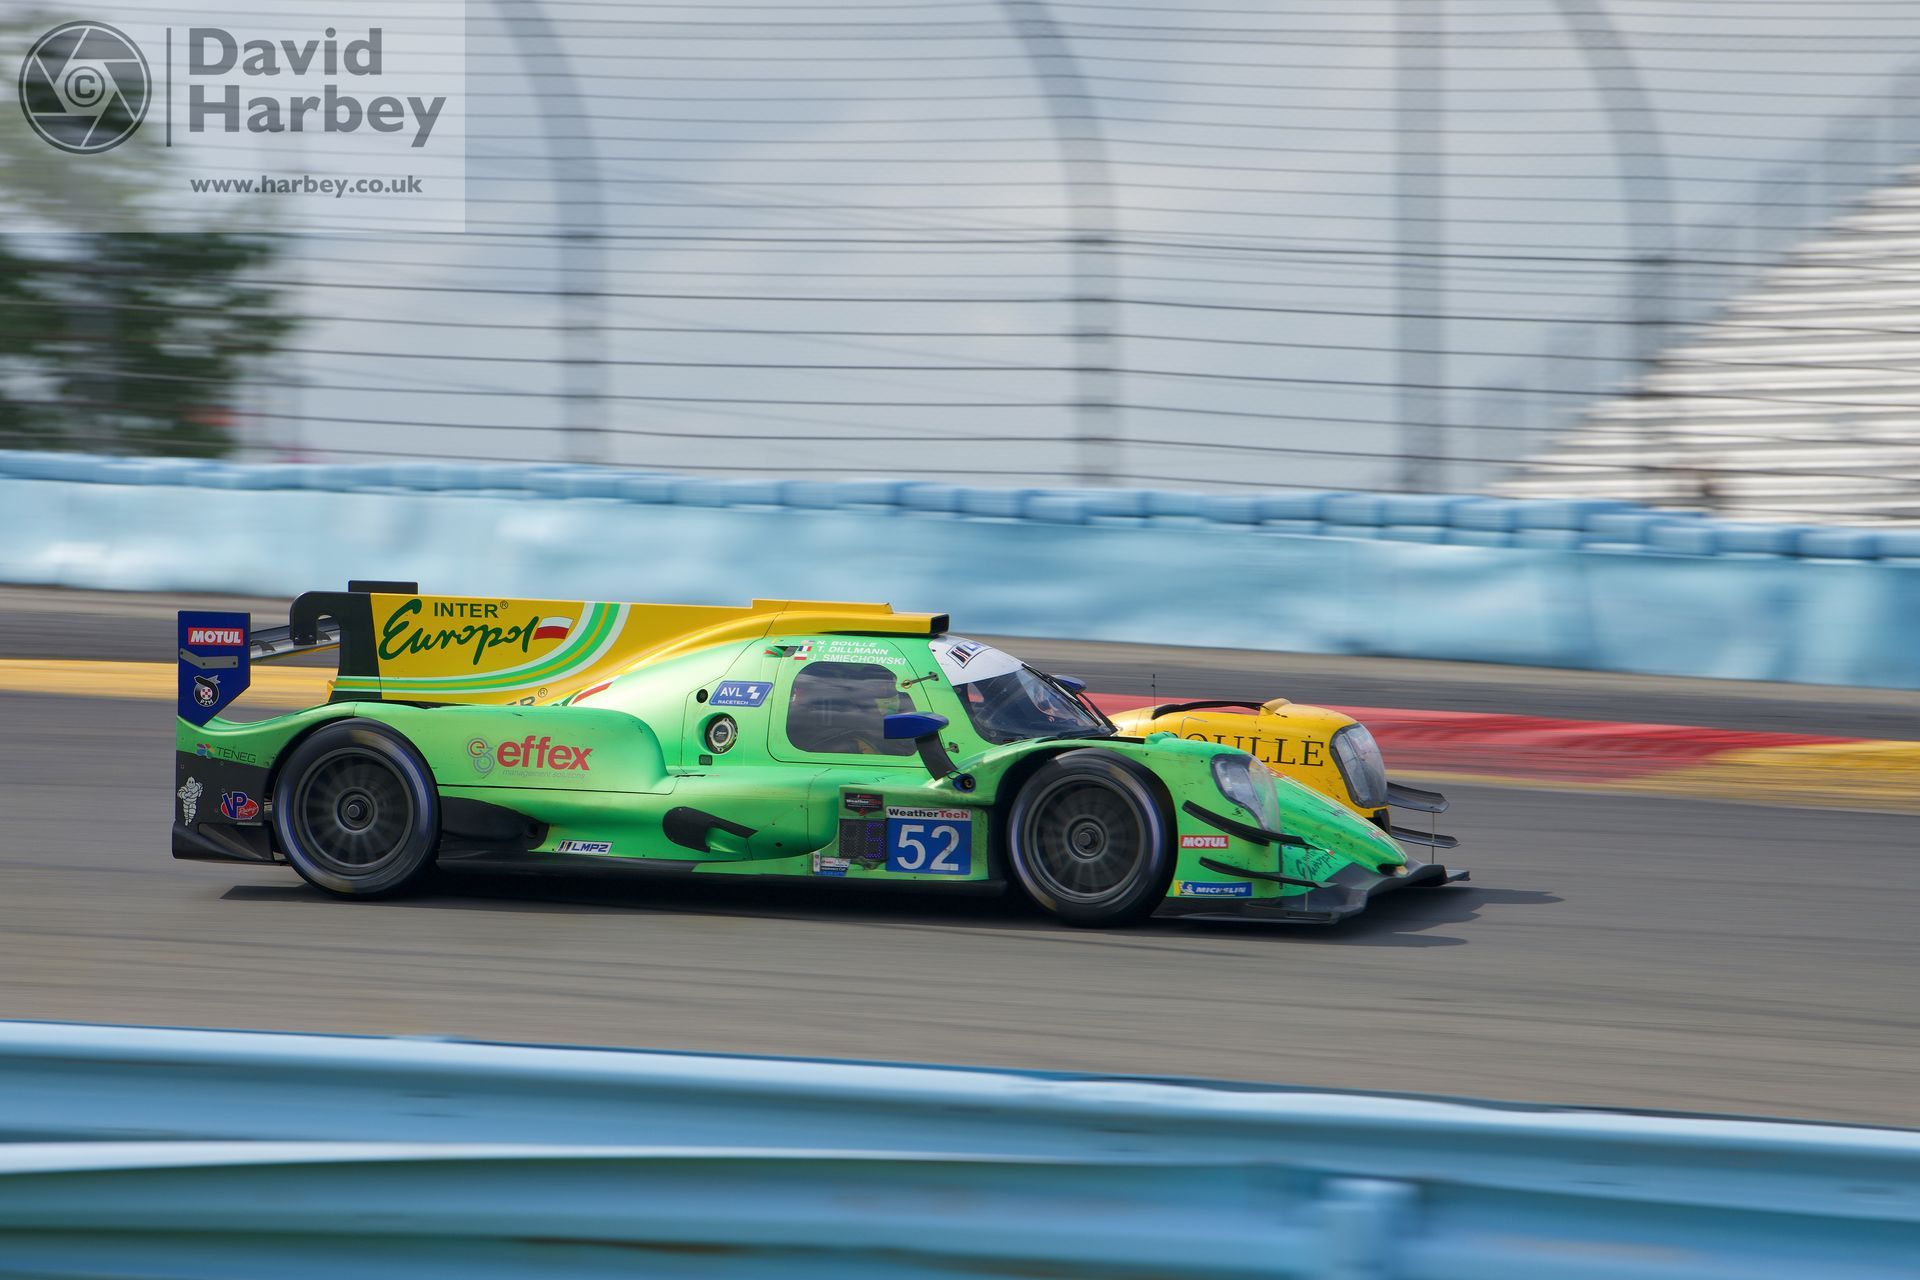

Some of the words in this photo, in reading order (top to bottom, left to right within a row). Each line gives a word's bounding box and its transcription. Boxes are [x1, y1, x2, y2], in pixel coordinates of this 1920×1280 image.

[190, 630, 241, 644] MOTUL
[379, 599, 540, 666] Europol
[829, 646, 888, 655] DILLMANN
[823, 654, 906, 665] SMIECHOWSKI
[720, 687, 743, 697] AVL
[216, 746, 257, 763] TENEG
[496, 735, 593, 771] effex
[222, 791, 248, 819] VP
[888, 808, 969, 819] WeatherTech
[572, 843, 609, 853] LMP2
[896, 824, 960, 871] 52
[1182, 837, 1227, 847] MOTUL
